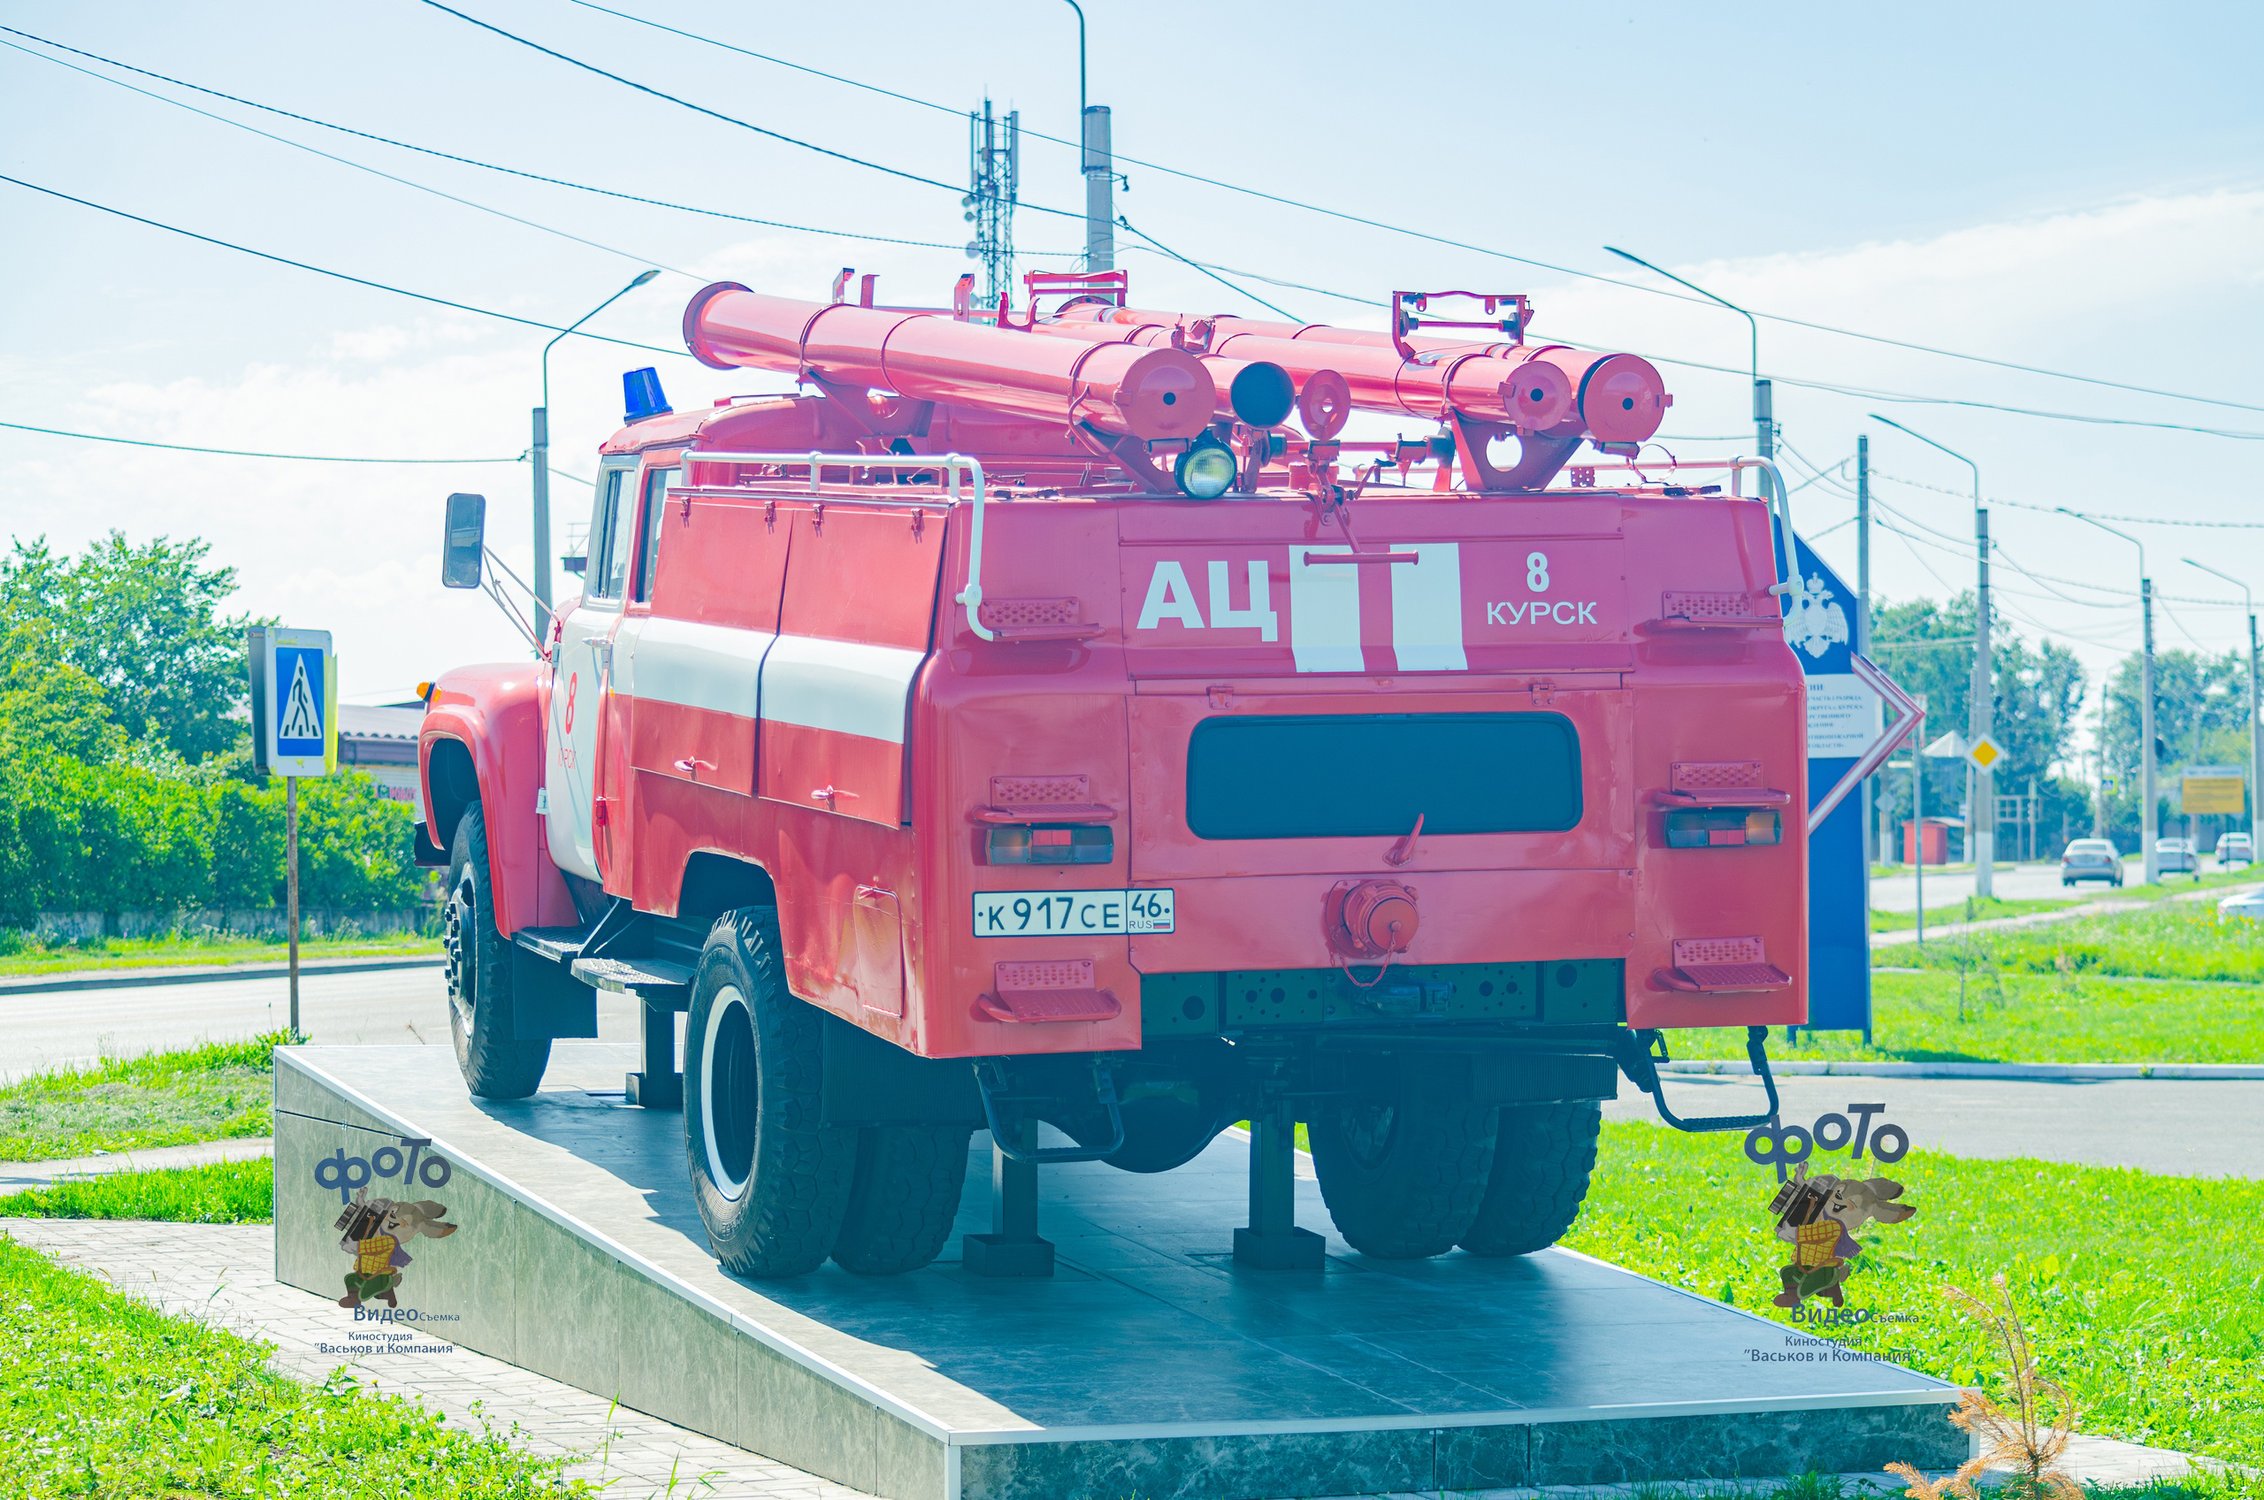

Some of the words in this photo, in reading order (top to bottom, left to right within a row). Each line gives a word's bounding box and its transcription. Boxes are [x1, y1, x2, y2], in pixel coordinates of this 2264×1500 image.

[1526, 551, 1550, 593] 8
[1136, 560, 1278, 642] АЦ
[1486, 600, 1598, 625] КУРСК
[565, 671, 578, 735] 8
[1131, 893, 1163, 918] 46
[1129, 920, 1153, 930] RUS
